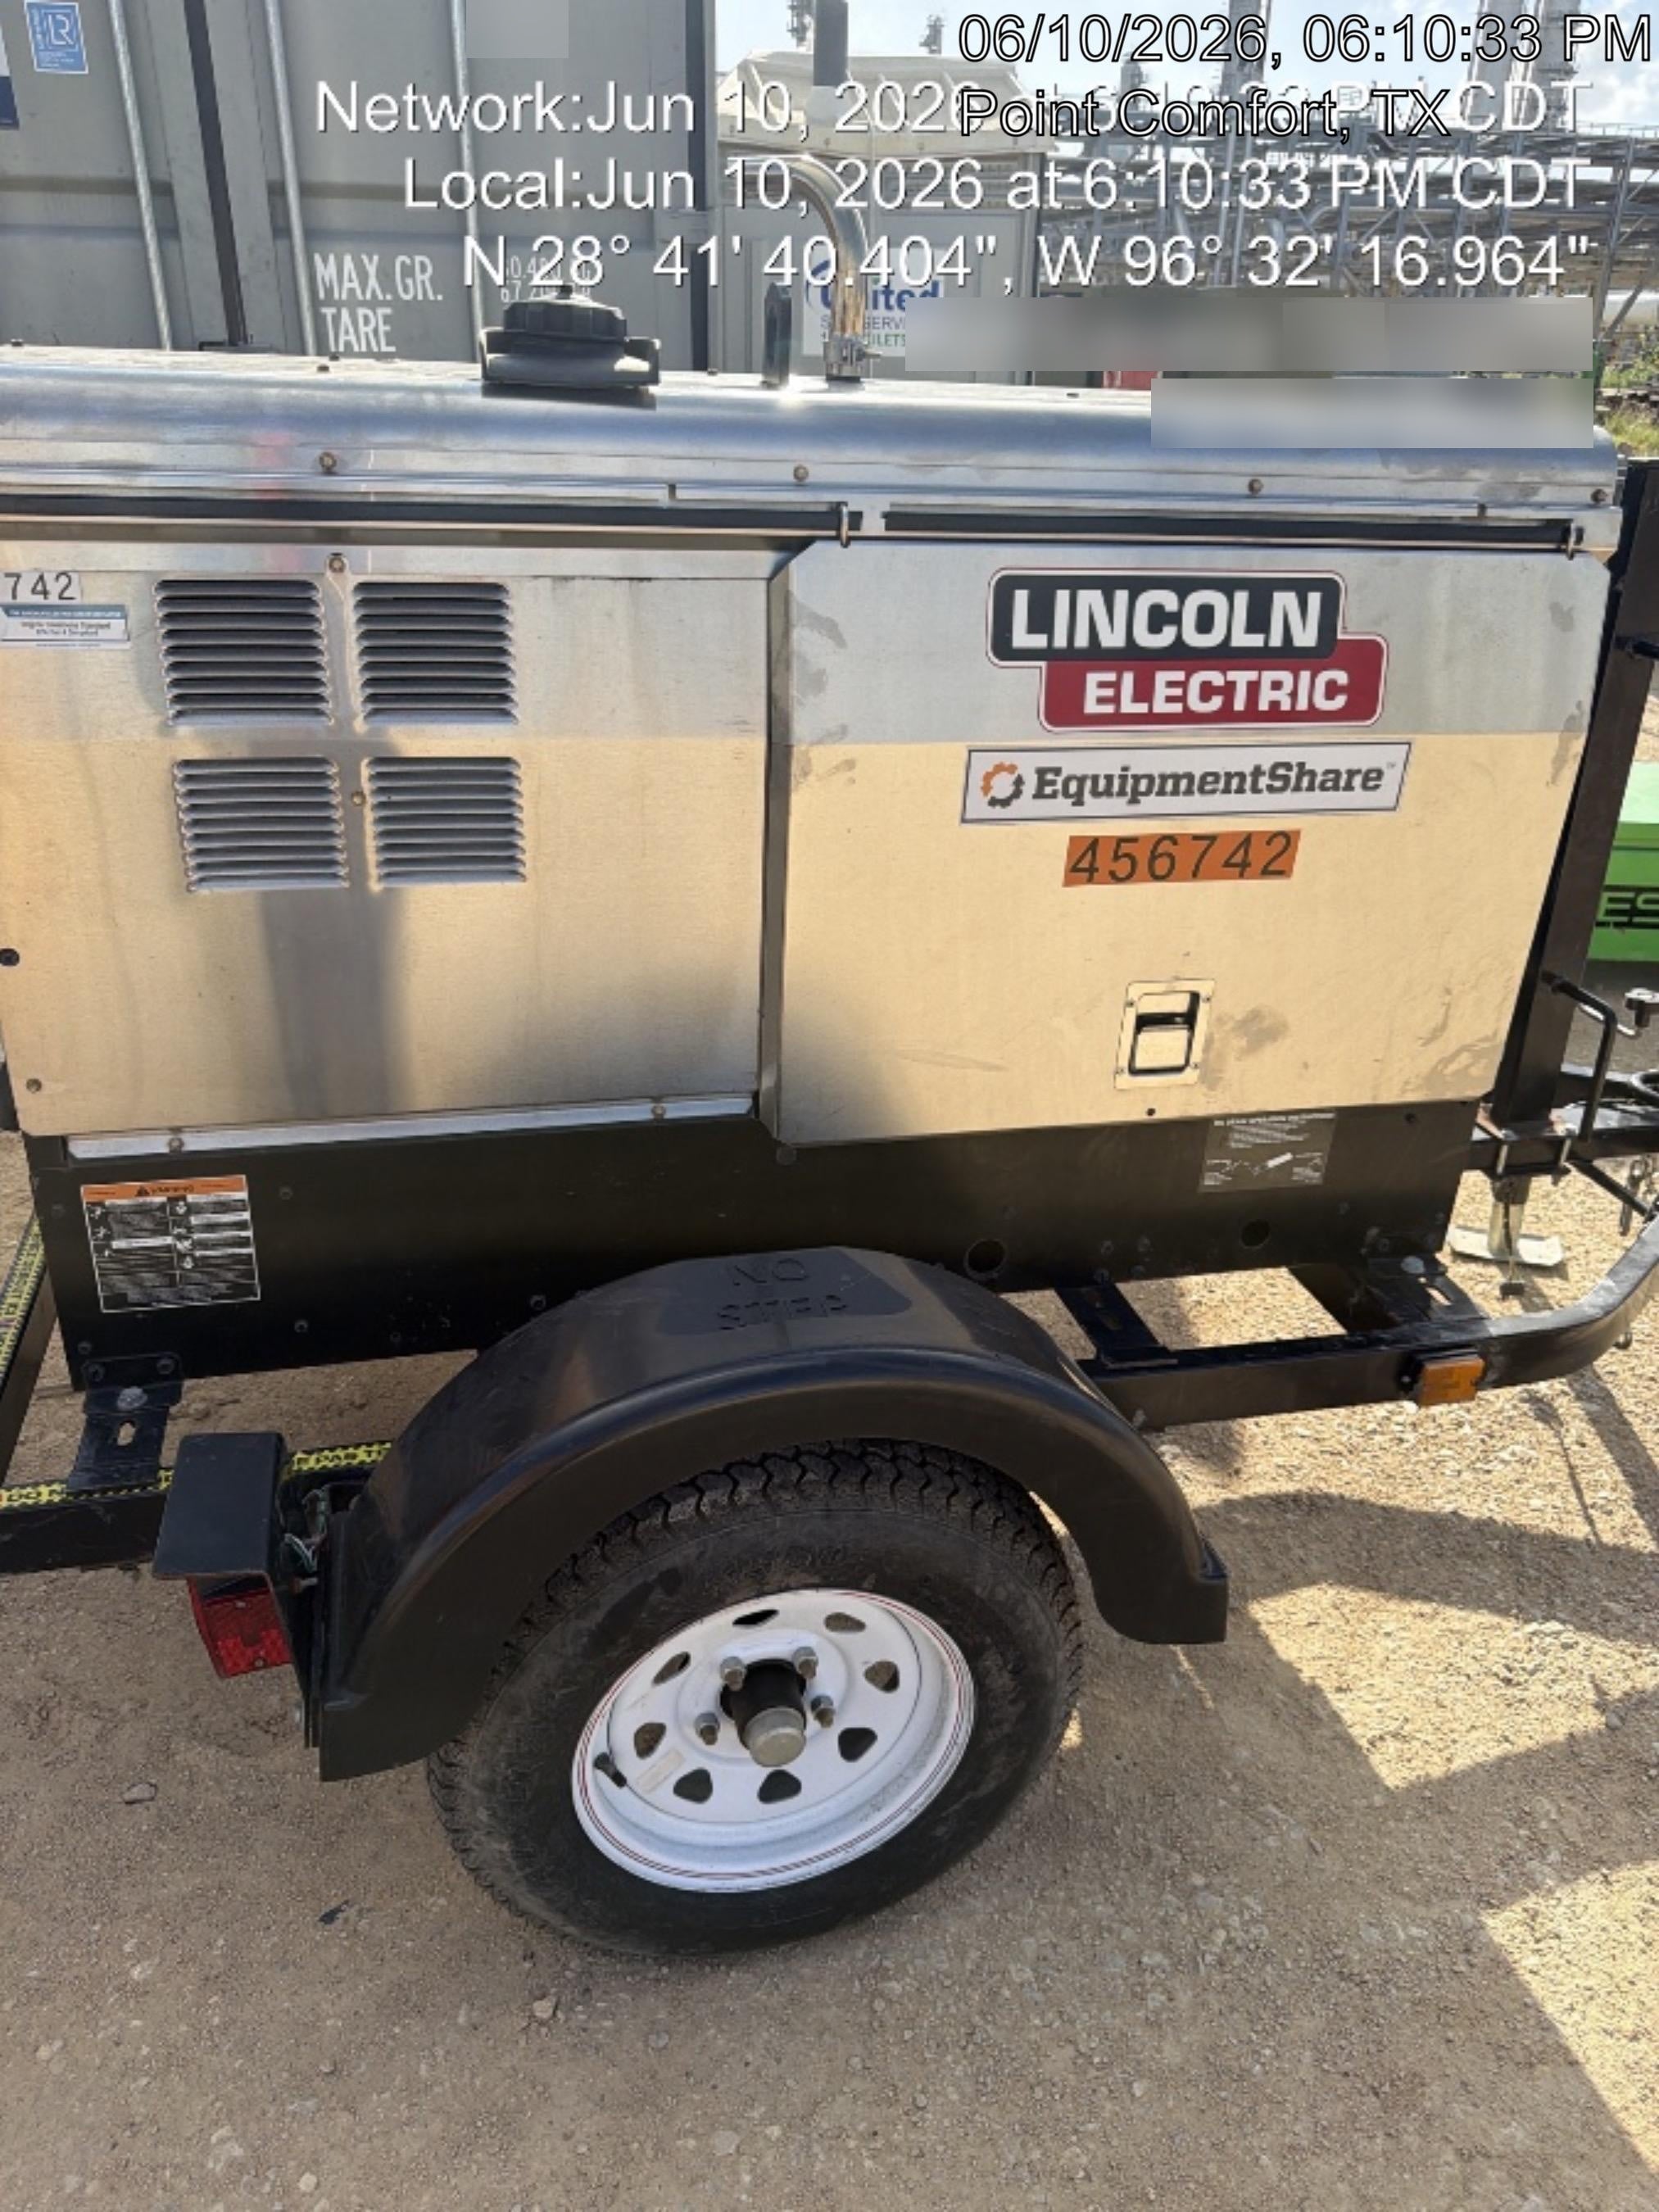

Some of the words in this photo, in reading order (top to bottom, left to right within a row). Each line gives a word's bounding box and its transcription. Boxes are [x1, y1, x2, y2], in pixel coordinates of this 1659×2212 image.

[320, 307, 397, 352] TARE
[4, 571, 77, 601] 742
[1011, 588, 1322, 650] LINCOLN
[1083, 669, 1349, 715] ELECTRIC
[1031, 760, 1385, 808] EquipmentShare
[1068, 830, 1292, 884] 456742
